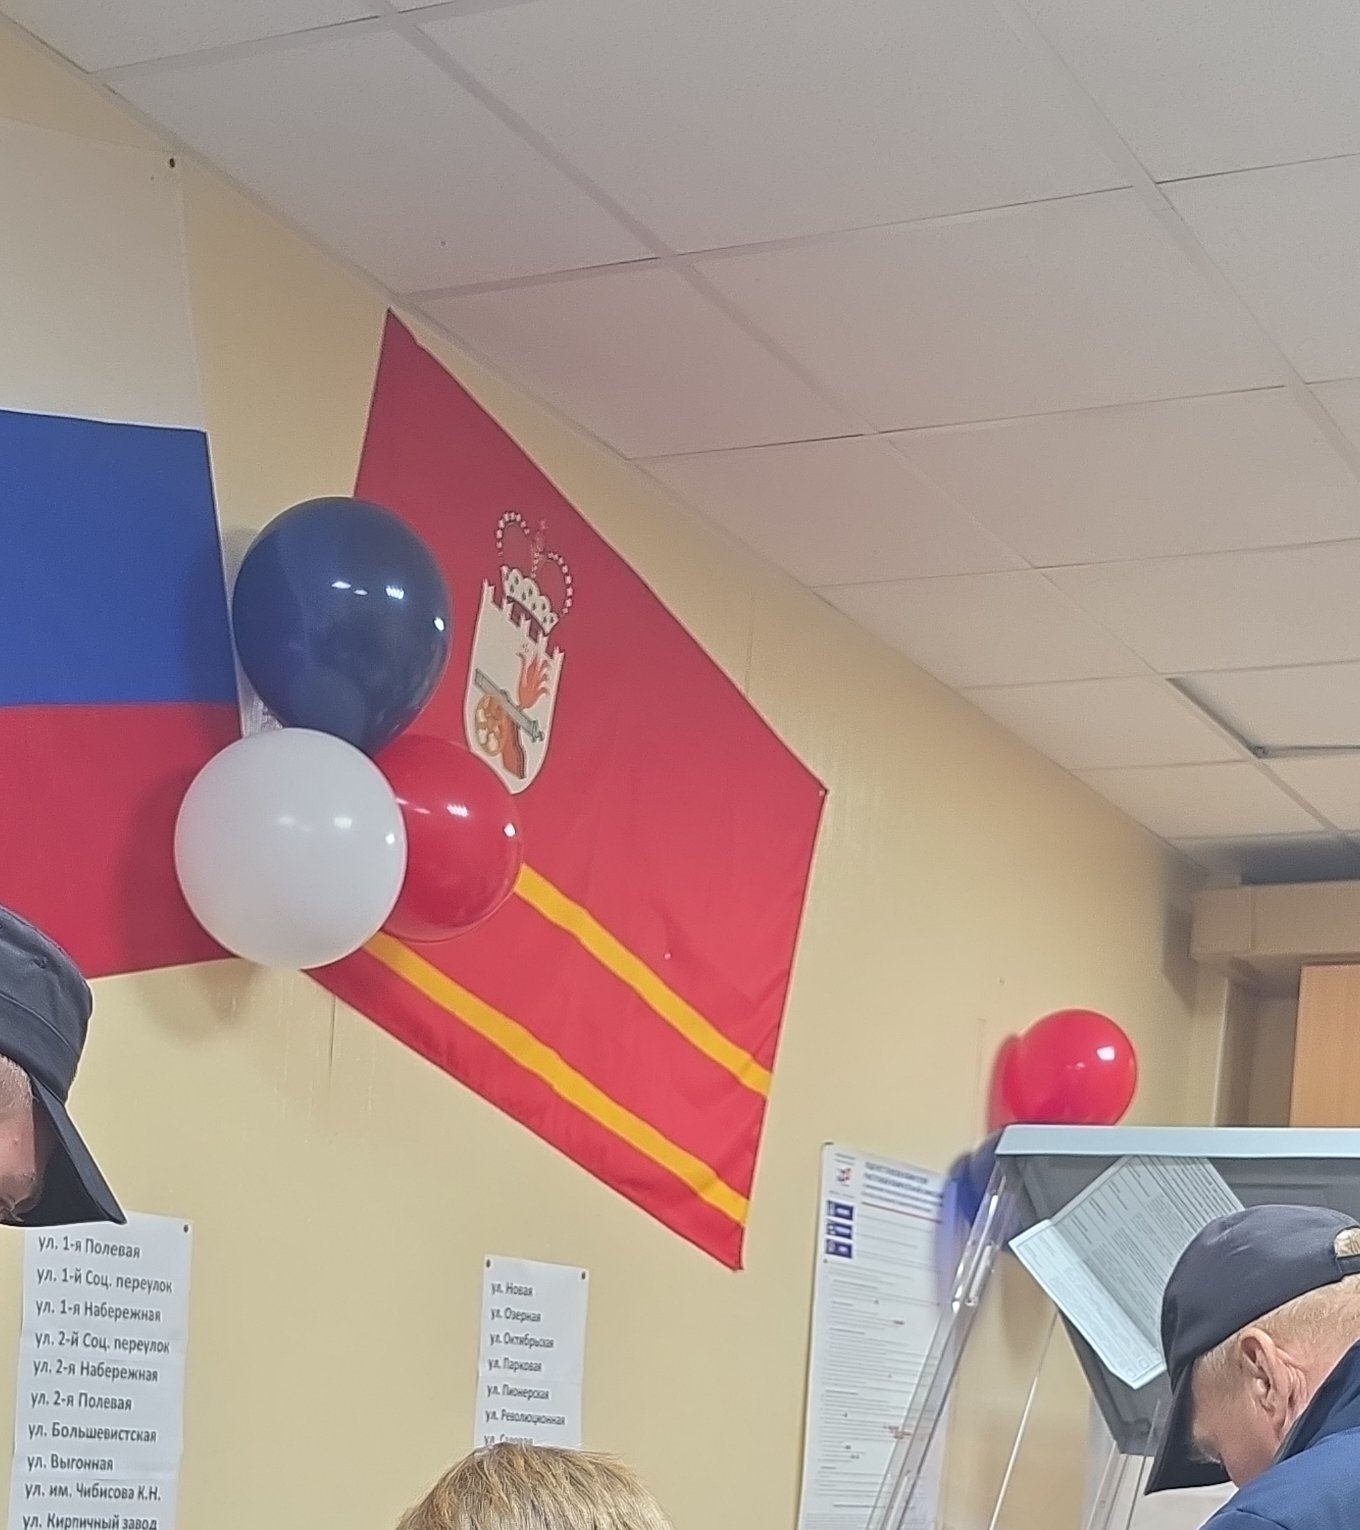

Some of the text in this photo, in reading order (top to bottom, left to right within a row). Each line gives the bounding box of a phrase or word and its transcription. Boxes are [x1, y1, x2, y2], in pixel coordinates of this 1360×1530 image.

[38, 1235, 141, 1259] ул. 1-я Полевая
[37, 1267, 173, 1295] ул. 1-й Соц. переулок
[491, 1282, 533, 1297] ул. Новая
[36, 1299, 161, 1322] ул. 1-я Набережная
[491, 1307, 502, 1321] ул.
[35, 1330, 170, 1355] ул. 2-й Соц. переулок
[490, 1332, 554, 1349] ул. Октябрьская
[33, 1359, 158, 1382] ул. 2-я Набережная
[488, 1357, 542, 1373] ул. Парковая
[31, 1390, 133, 1411] ул. 2-я Полевая
[487, 1384, 550, 1401] ул. Пионерская
[485, 1409, 566, 1426] ул. Революционная
[28, 1421, 157, 1443] ул. Большевистская
[27, 1453, 113, 1472] ул. Выгонная
[25, 1482, 161, 1501] ул. им. Чибисова К.Н.
[23, 1515, 42, 1530] ул.
